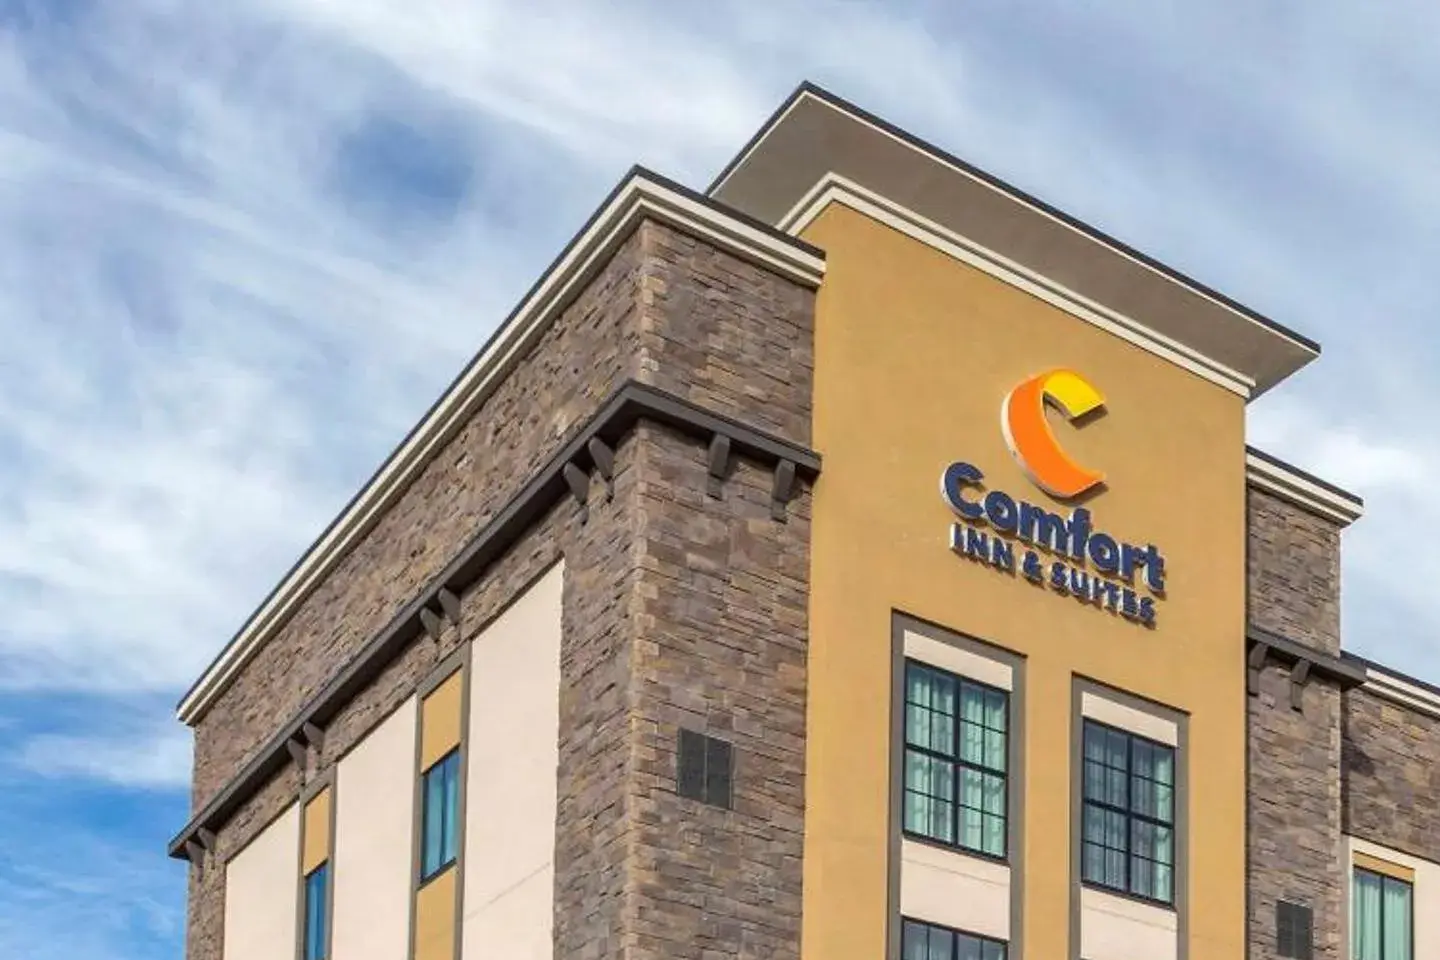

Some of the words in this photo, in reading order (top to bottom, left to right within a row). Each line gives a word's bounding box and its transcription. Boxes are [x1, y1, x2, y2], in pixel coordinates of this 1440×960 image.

[941, 461, 1165, 593] Comfort
[950, 522, 1015, 572] INN
[1021, 550, 1044, 586] &
[1050, 561, 1156, 625] SUITES
